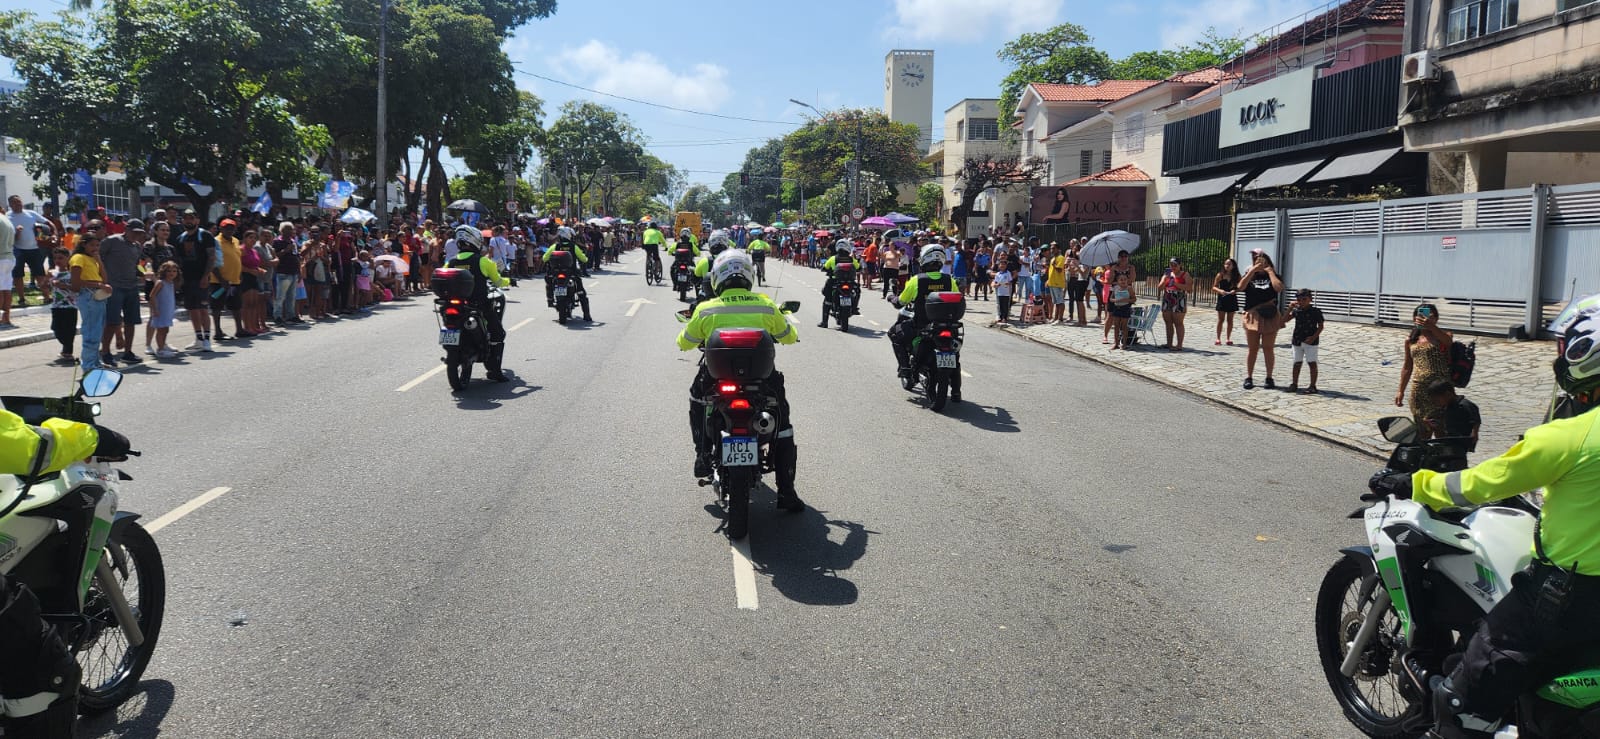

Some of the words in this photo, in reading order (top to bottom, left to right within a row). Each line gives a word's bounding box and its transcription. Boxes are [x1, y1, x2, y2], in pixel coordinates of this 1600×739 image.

[1240, 97, 1277, 126] LOOK
[1075, 200, 1119, 214] LOOK
[730, 442, 750, 453] RCI
[726, 452, 754, 463] 6F59
